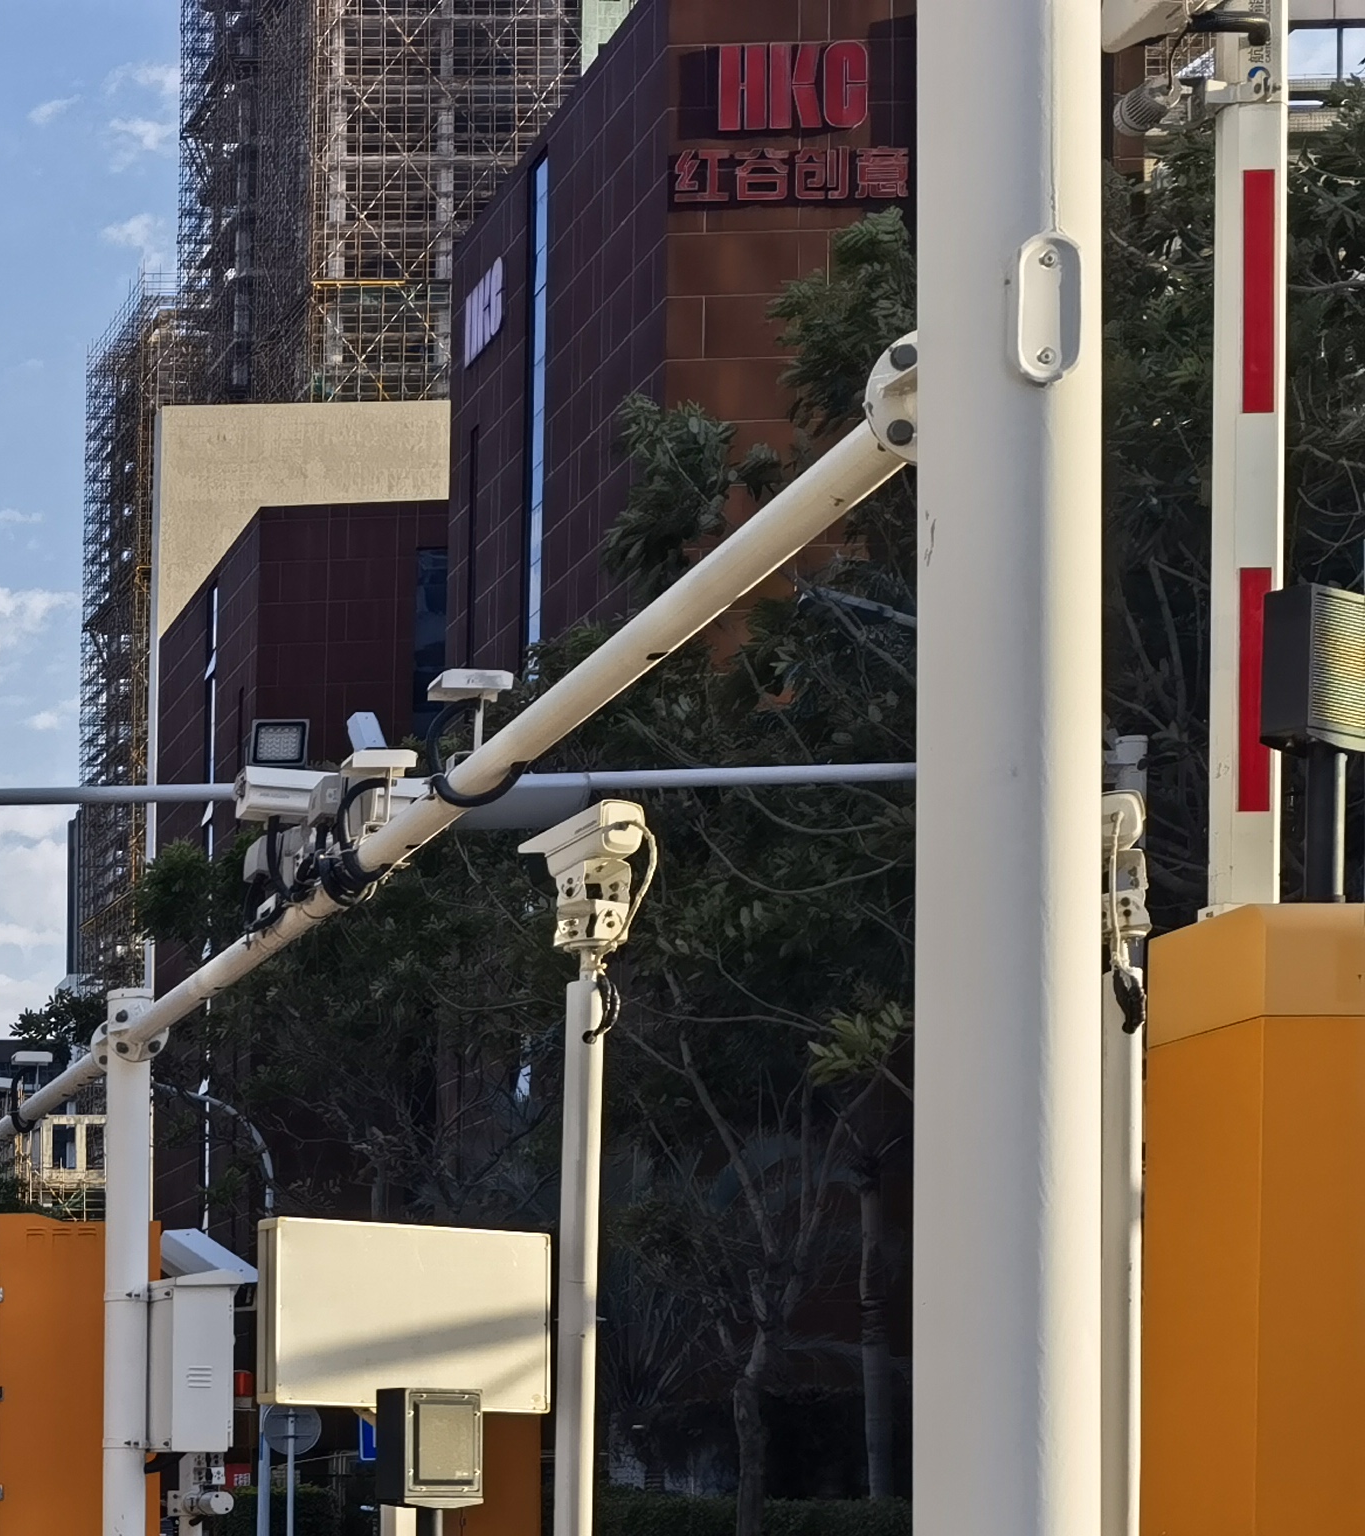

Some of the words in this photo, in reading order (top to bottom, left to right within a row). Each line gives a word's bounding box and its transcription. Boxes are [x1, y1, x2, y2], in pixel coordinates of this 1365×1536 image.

[1248, 0, 1264, 63] 航能
[718, 40, 868, 131] HKC
[674, 146, 909, 202] 红谷创意
